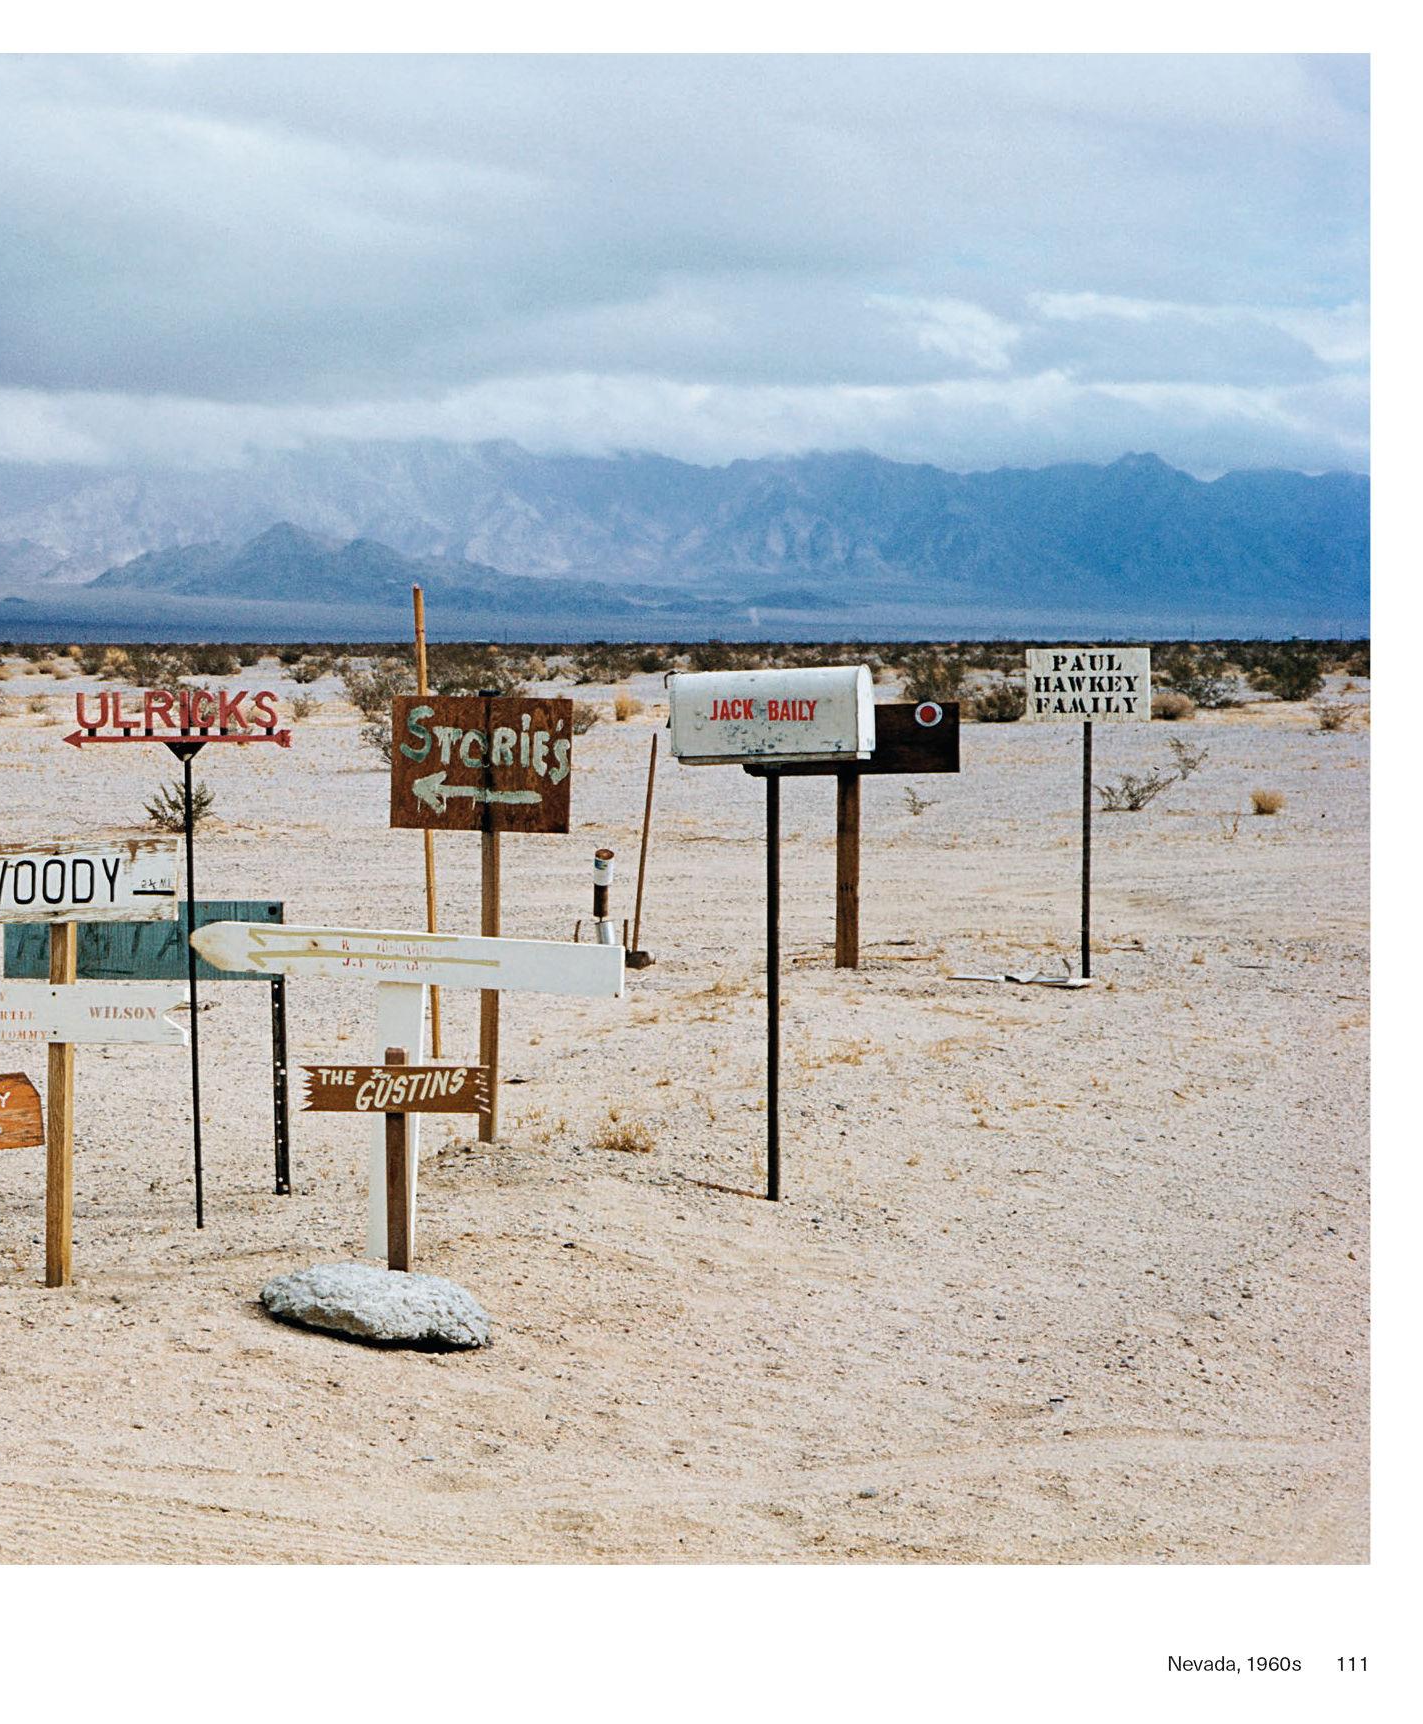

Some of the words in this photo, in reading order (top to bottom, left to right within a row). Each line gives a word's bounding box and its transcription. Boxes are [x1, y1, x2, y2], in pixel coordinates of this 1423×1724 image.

[1052, 654, 1122, 671] PAUL
[1034, 676, 1139, 693] HAWKEY
[76, 690, 279, 729] ULRICKS
[710, 699, 754, 721] JACK
[768, 700, 817, 721] BAILY
[1036, 697, 1138, 714] FAMILY
[89, 1006, 157, 1019] WILSON
[318, 1068, 356, 1086] THE
[355, 1067, 468, 1111] GUSTINS
